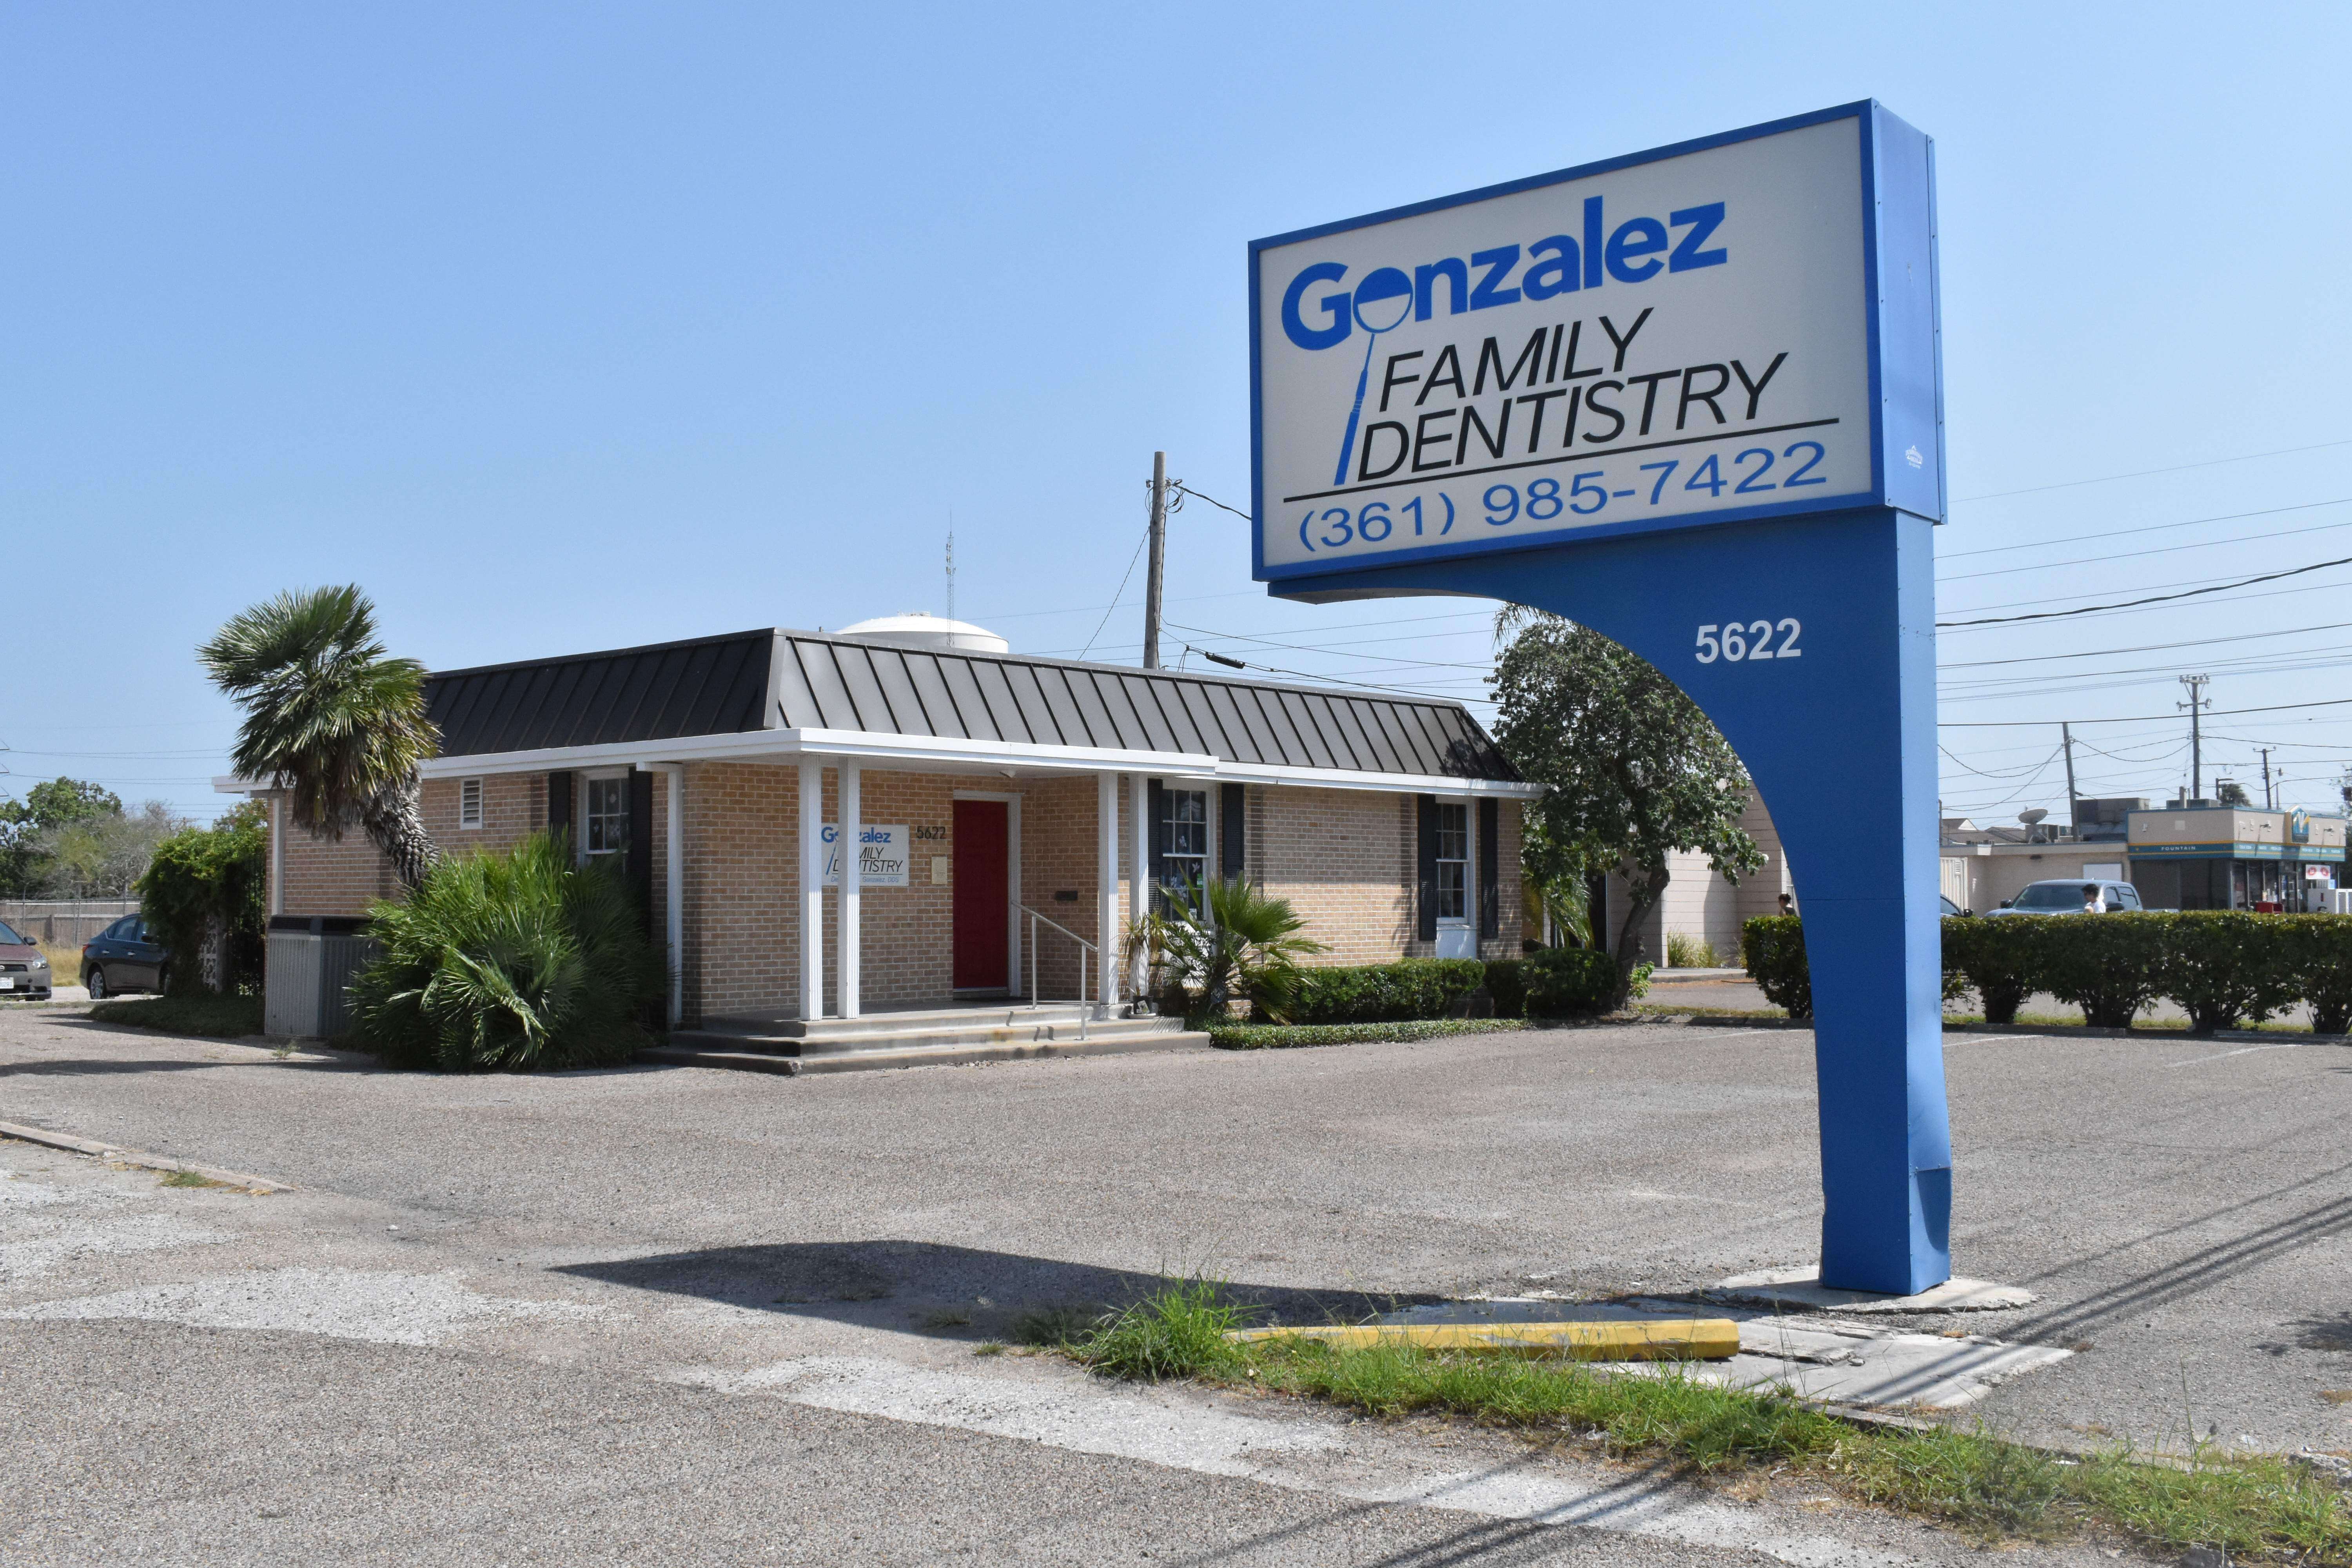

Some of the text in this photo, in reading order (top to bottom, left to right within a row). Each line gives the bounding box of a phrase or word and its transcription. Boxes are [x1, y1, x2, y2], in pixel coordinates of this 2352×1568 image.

[1281, 194, 1728, 351] Gonzalez
[1379, 307, 1655, 412] FAMILY
[1357, 352, 1789, 482] DENTISTRY
[1299, 440, 1828, 552] (361) 985-7422
[1695, 618, 1801, 664] 5622
[821, 826, 891, 843] Galez
[916, 826, 946, 839] 5622
